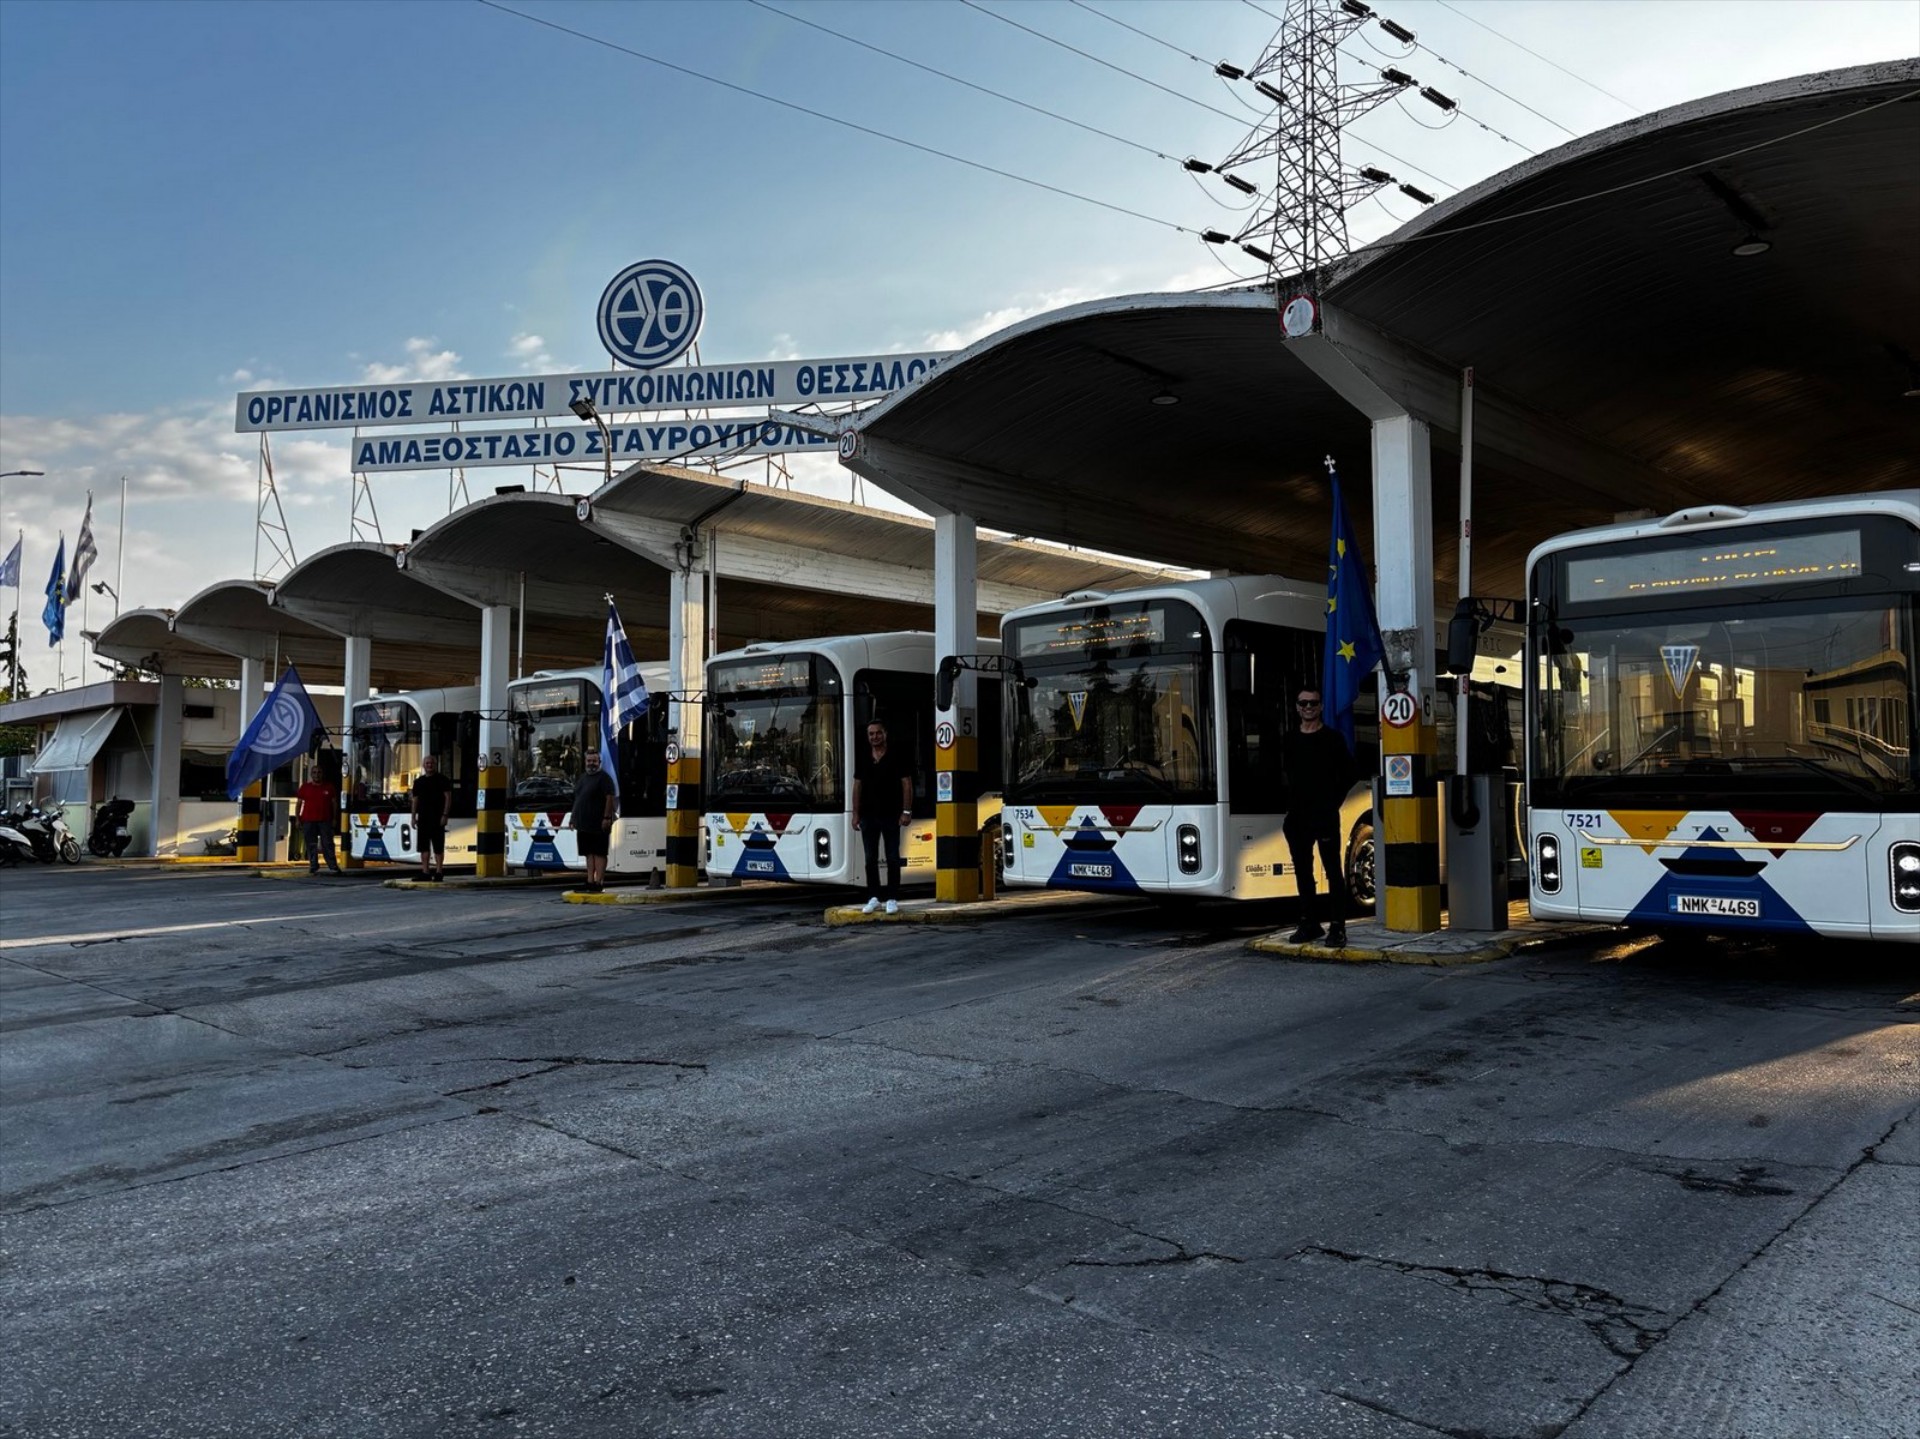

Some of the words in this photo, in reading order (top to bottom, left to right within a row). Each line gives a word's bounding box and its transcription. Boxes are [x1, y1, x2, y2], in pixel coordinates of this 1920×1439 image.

[248, 389, 412, 425] ΟΡΓΑΝΙΣΜΟΣ
[428, 382, 545, 416] ΑΣΤΙΚΩΝ
[568, 368, 776, 407] ΣΥΓΚΟΙΝΩΝΙΩΝ
[796, 358, 938, 396] ΘΕΣΣΑΛΟ
[357, 430, 577, 466] ΑΜΑΞΟΣΤΑΣΙΟ
[585, 421, 838, 454] ΣΤΑΥΡΟΥΠΟΛ
[841, 433, 855, 453] 20
[1388, 697, 1411, 721] 20
[1423, 694, 1431, 717] 6
[962, 717, 973, 735] 5
[939, 727, 952, 744] 20
[493, 752, 502, 766] 3
[1015, 809, 1034, 819] 7534
[1567, 814, 1601, 828] 7521
[1642, 825, 1783, 833] YUTONG
